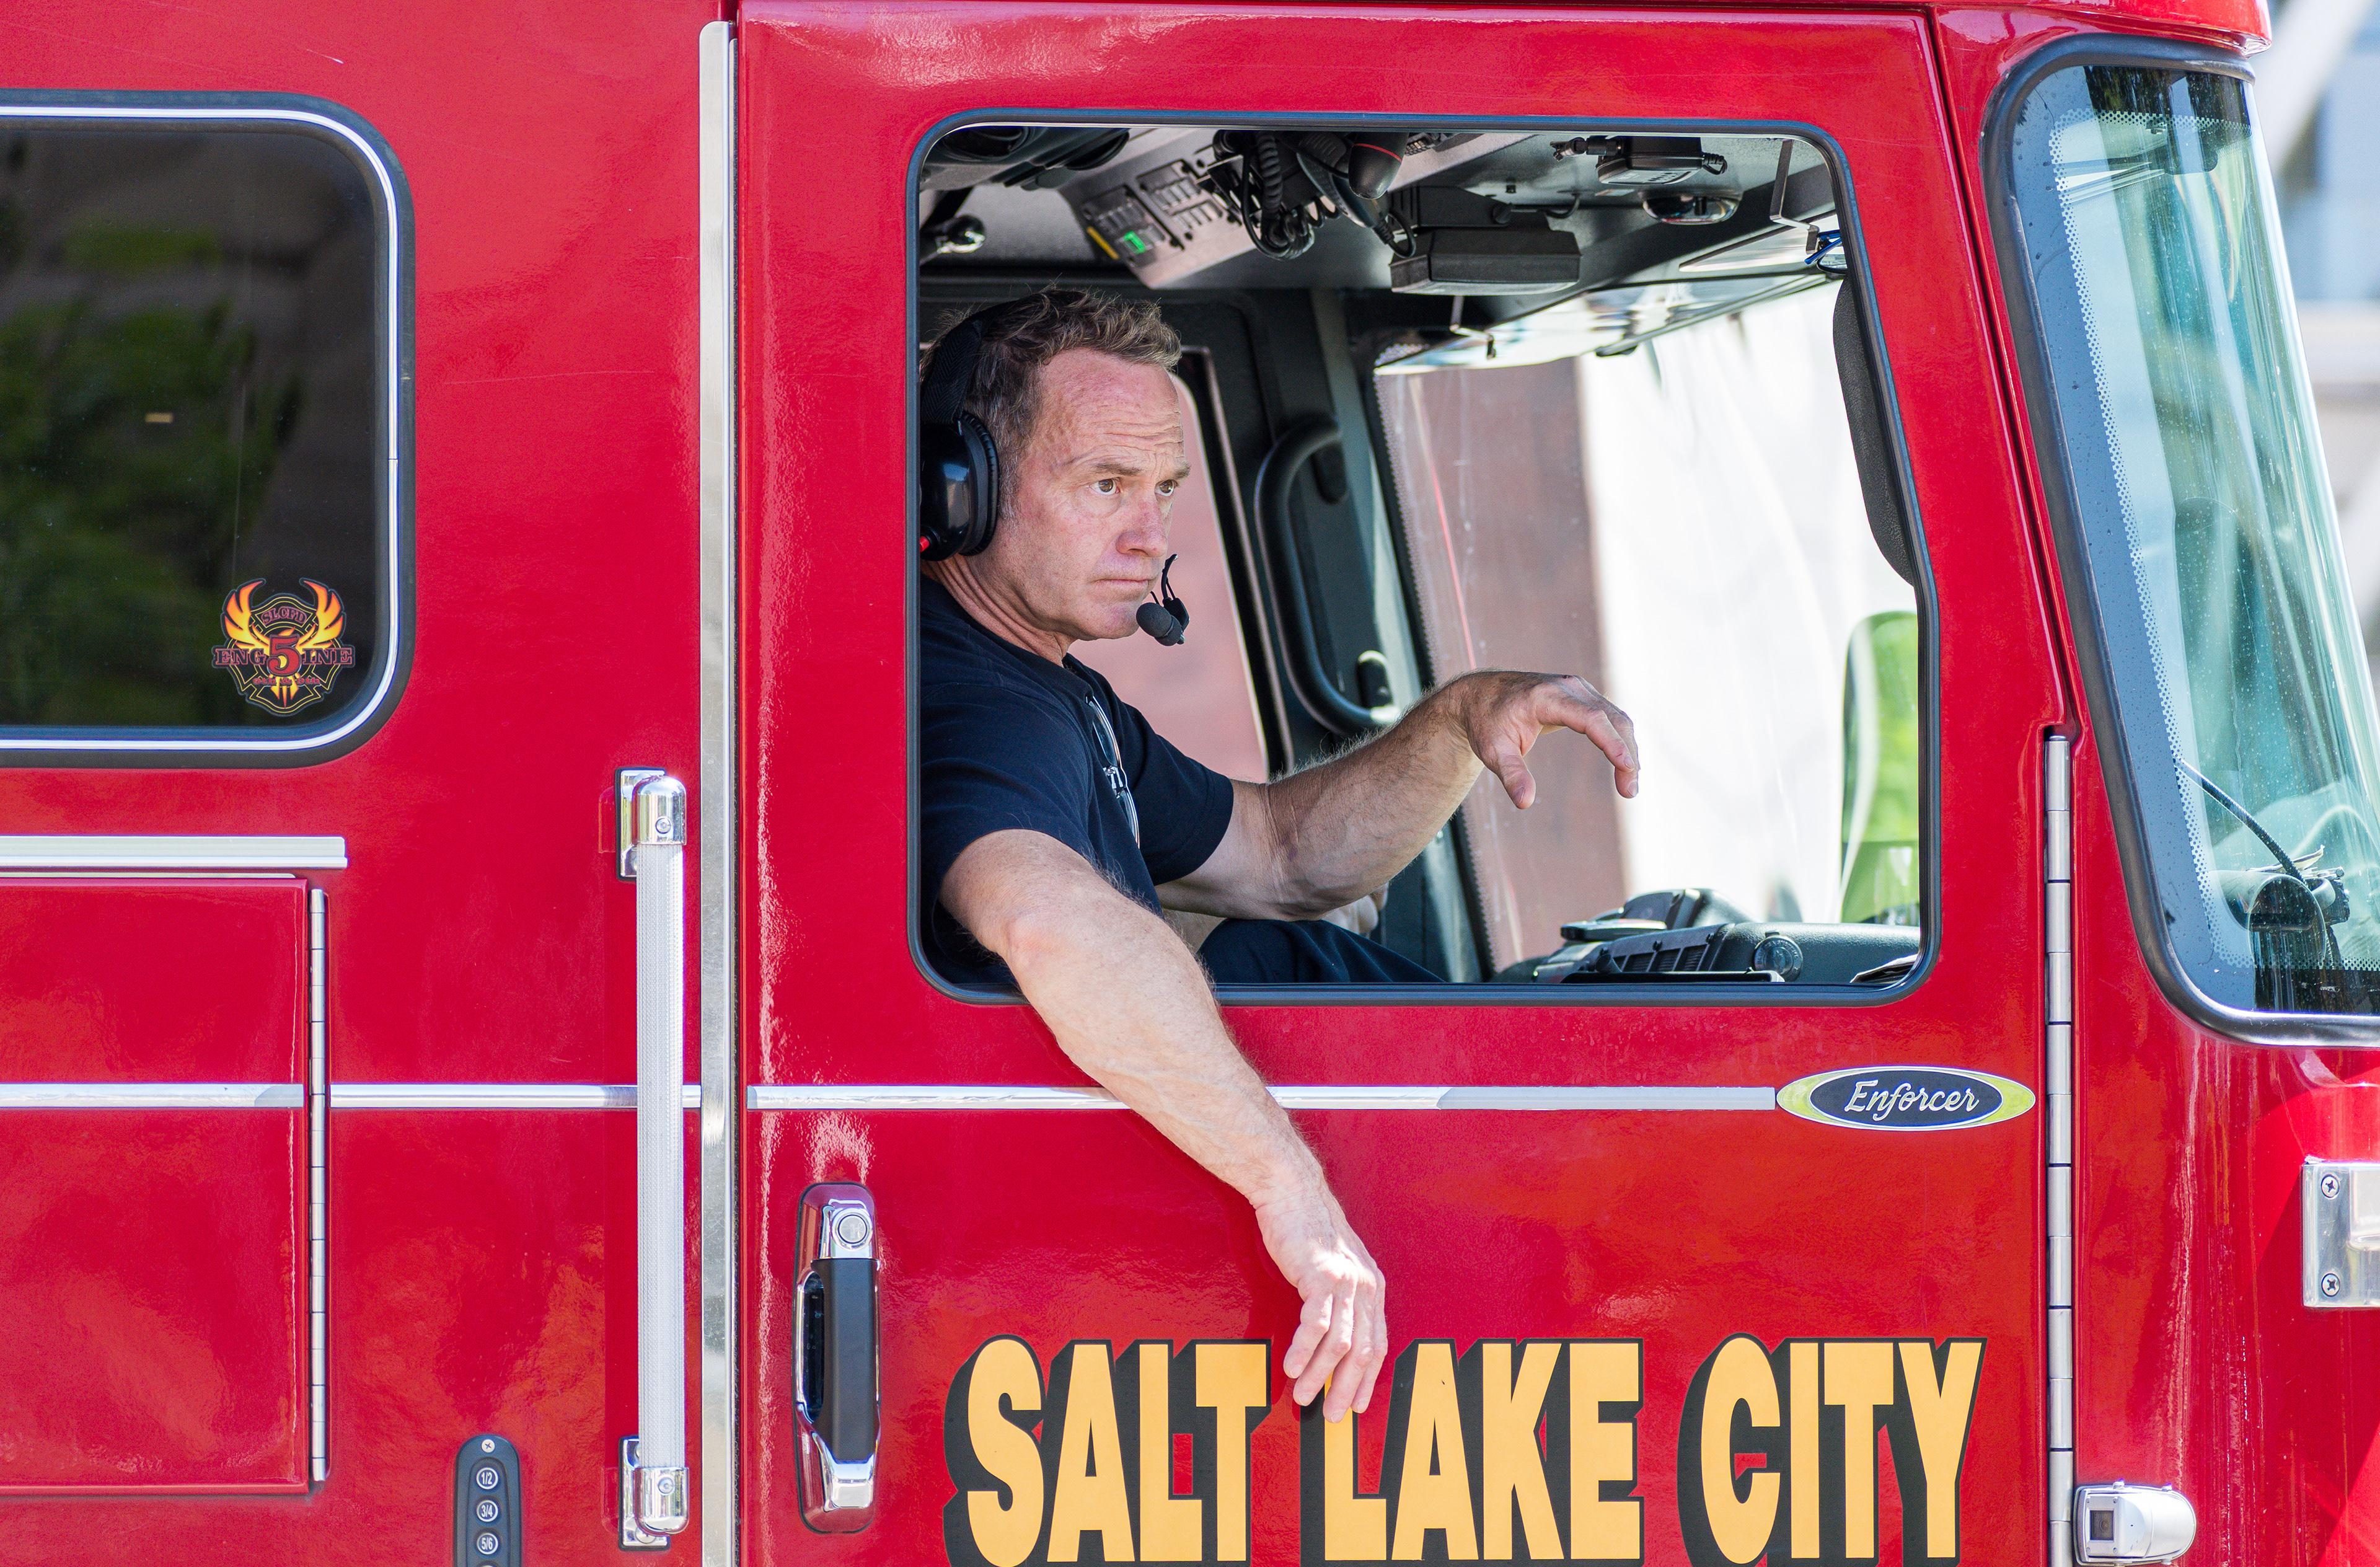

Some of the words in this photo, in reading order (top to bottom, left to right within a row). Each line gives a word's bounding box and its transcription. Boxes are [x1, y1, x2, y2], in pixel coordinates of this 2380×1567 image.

[261, 606, 308, 626] SLCFD
[267, 634, 302, 676] 5
[1844, 1079, 1980, 1121] Enforcer
[965, 1337, 1267, 1567] SALT
[1320, 1342, 1641, 1562] LAKE
[1699, 1337, 1983, 1565] CITY
[481, 1472, 493, 1485] 1/2
[481, 1504, 493, 1517] 3/4
[481, 1537, 493, 1550] 5/6
